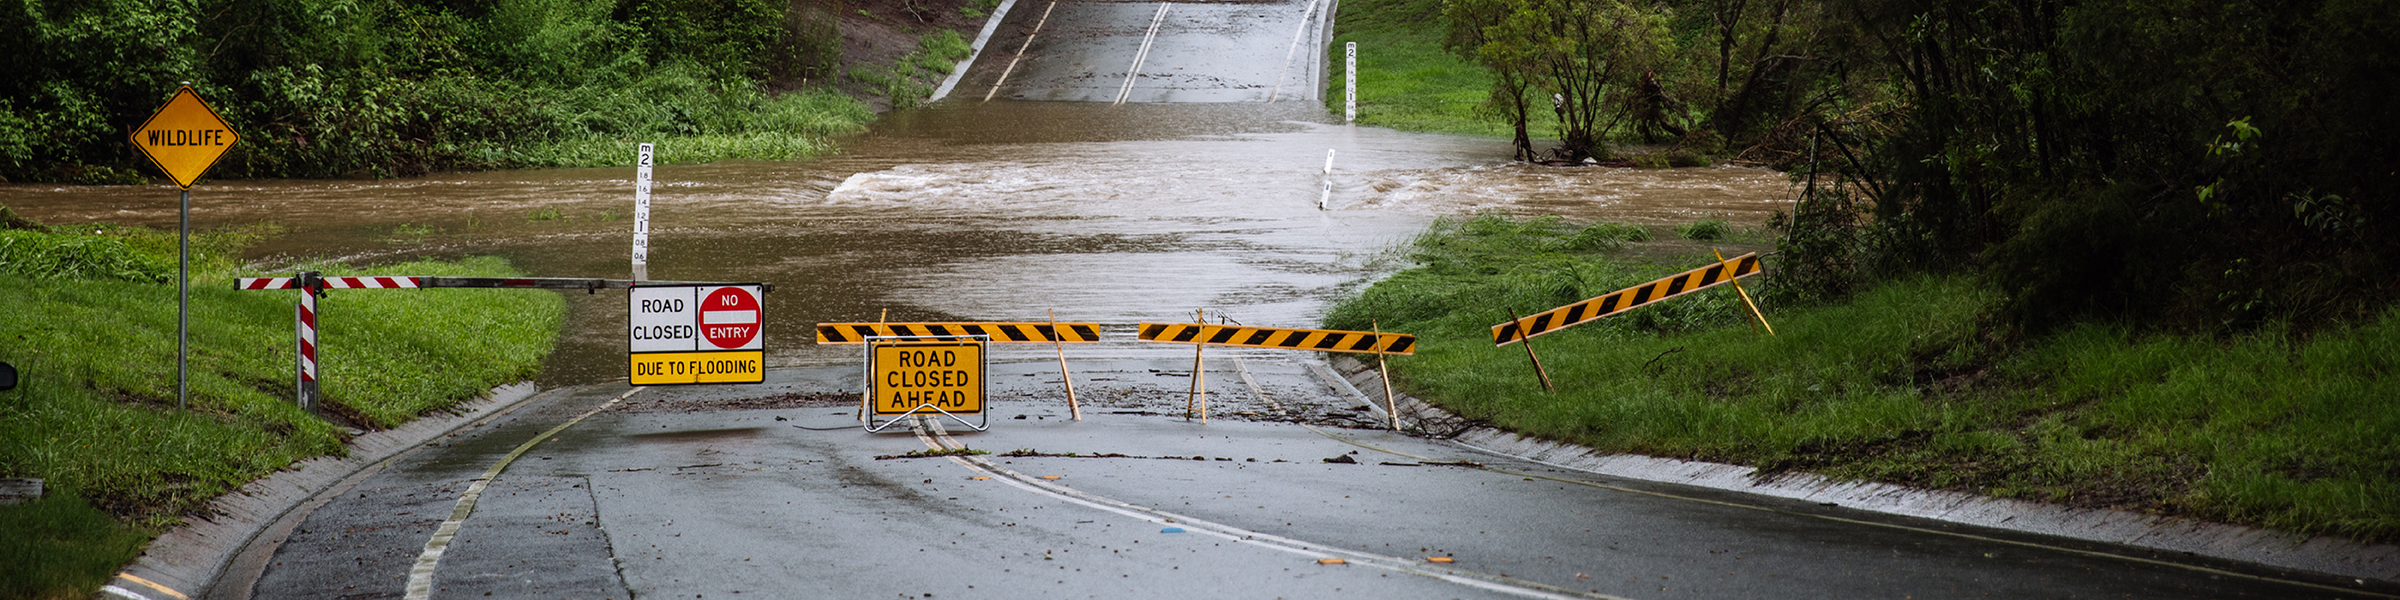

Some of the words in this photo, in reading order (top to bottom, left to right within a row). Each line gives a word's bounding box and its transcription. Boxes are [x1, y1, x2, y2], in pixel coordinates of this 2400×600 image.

[148, 129, 224, 146] WILDLIFE
[641, 153, 650, 165] 2
[641, 299, 684, 313] ROAD
[721, 294, 738, 306] NO
[633, 325, 693, 340] CLOSED
[710, 327, 750, 339] ENTRY
[899, 350, 956, 367] ROAD
[637, 362, 664, 376] DUE
[668, 361, 685, 375] TO
[689, 360, 756, 375] FLOODING
[887, 370, 968, 388] CLOSED
[891, 390, 966, 408] AHEAD
